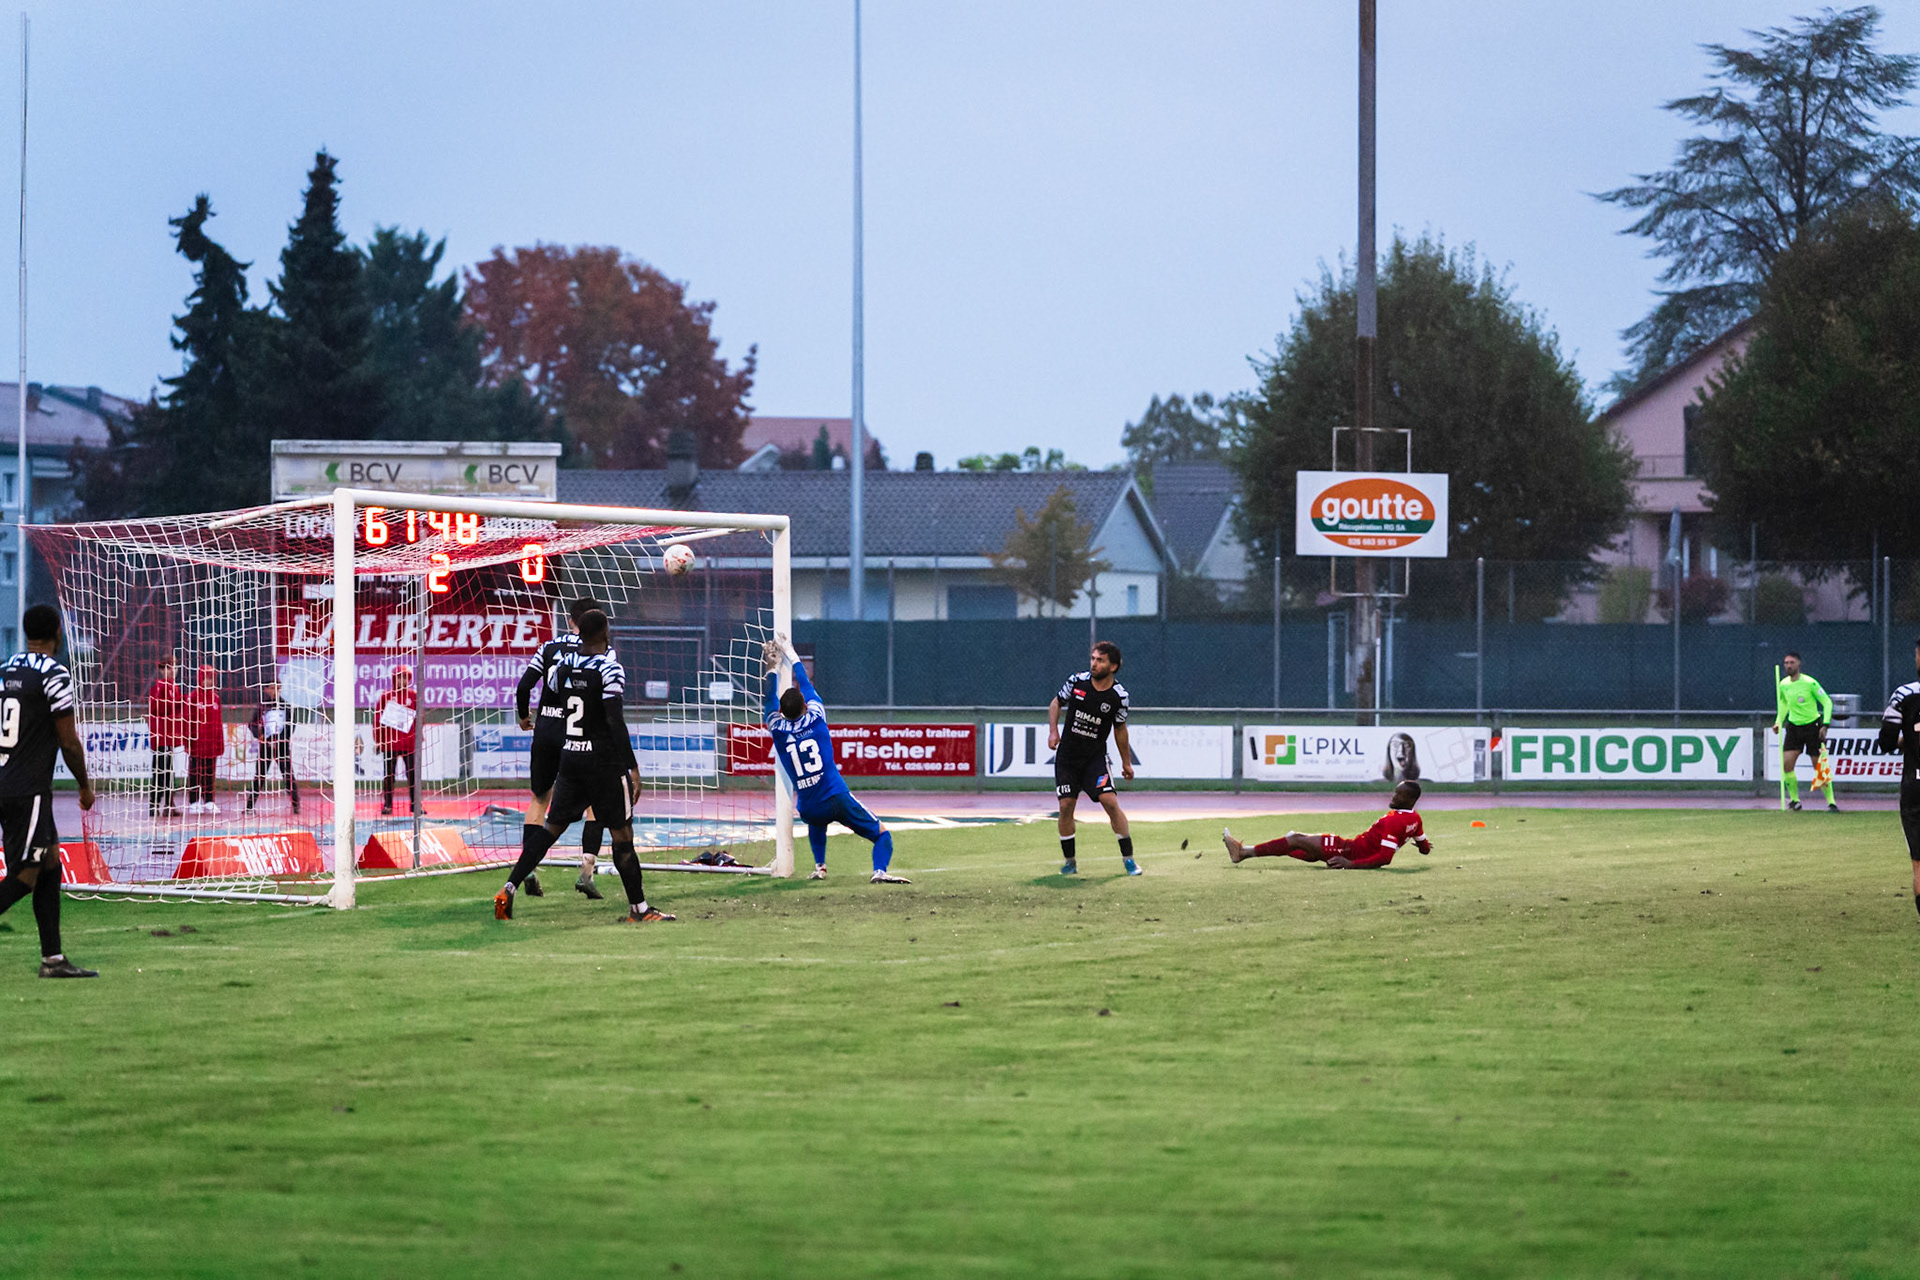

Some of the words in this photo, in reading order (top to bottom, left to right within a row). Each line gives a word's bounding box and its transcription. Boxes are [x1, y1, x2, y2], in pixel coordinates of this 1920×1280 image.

[350, 463, 401, 483] BCV
[488, 464, 539, 484] BCV
[1321, 493, 1424, 526] goutte
[429, 554, 450, 592] 2
[521, 544, 545, 582] 0
[355, 609, 543, 648] LIBERTÉ
[541, 705, 565, 718] AHME
[566, 695, 584, 736] 2
[829, 727, 870, 738] cuterie
[880, 727, 923, 738] Service
[926, 728, 970, 738] traiteur
[841, 741, 936, 759] Fischer
[785, 738, 824, 777] 13
[1512, 735, 1741, 774] FRICOPY
